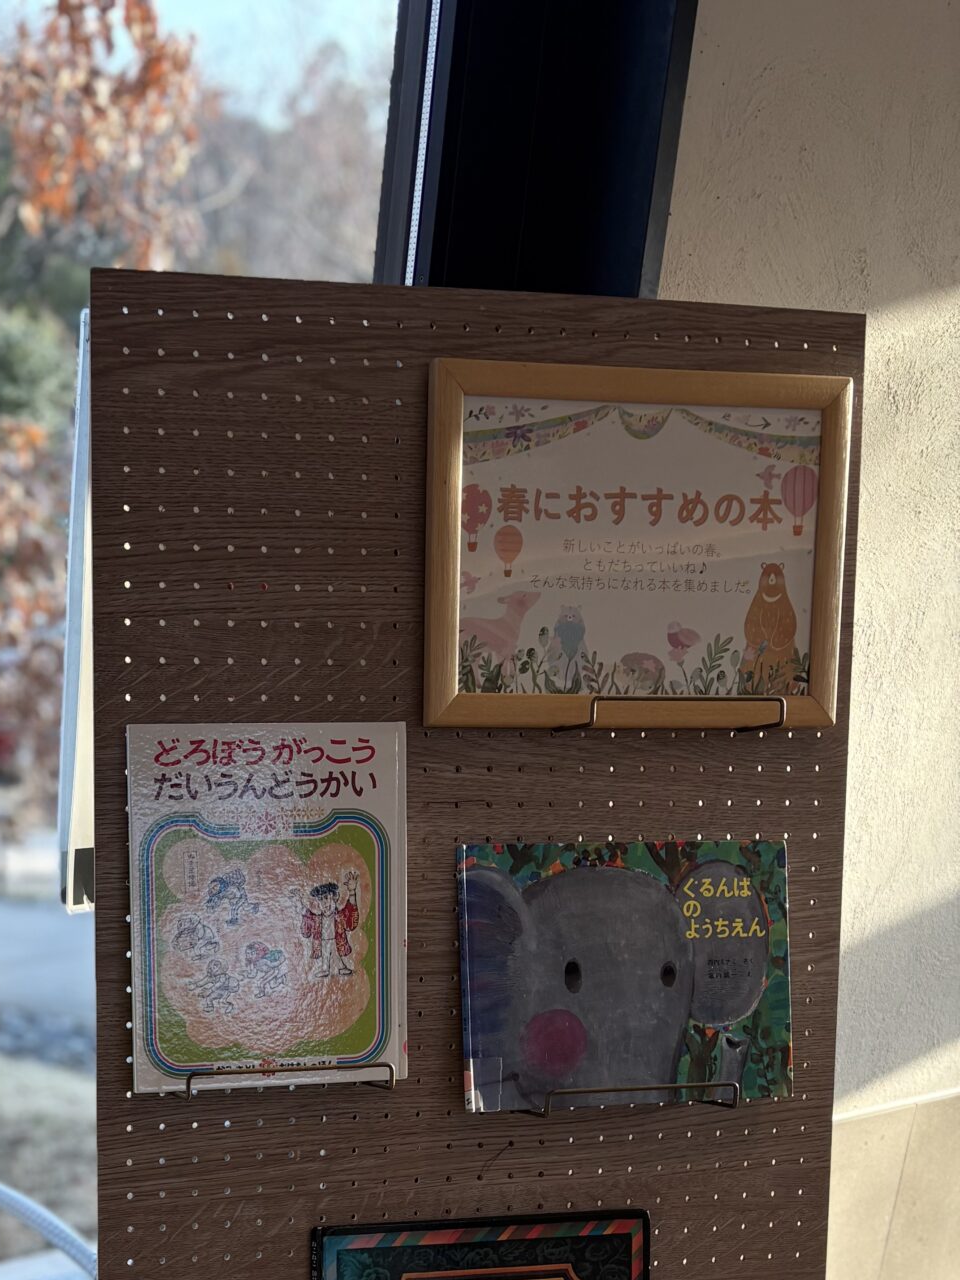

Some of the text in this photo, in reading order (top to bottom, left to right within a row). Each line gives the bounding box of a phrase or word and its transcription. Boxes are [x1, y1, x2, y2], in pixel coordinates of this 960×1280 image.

[497, 484, 783, 532] 春におすすめの本
[562, 538, 722, 559] 新しいことがいっぱいの春。
[154, 737, 376, 767] どろぼうがっこう
[154, 769, 377, 801] だいうんどうかい
[682, 900, 701, 918] の
[684, 917, 767, 939] ようちえん
